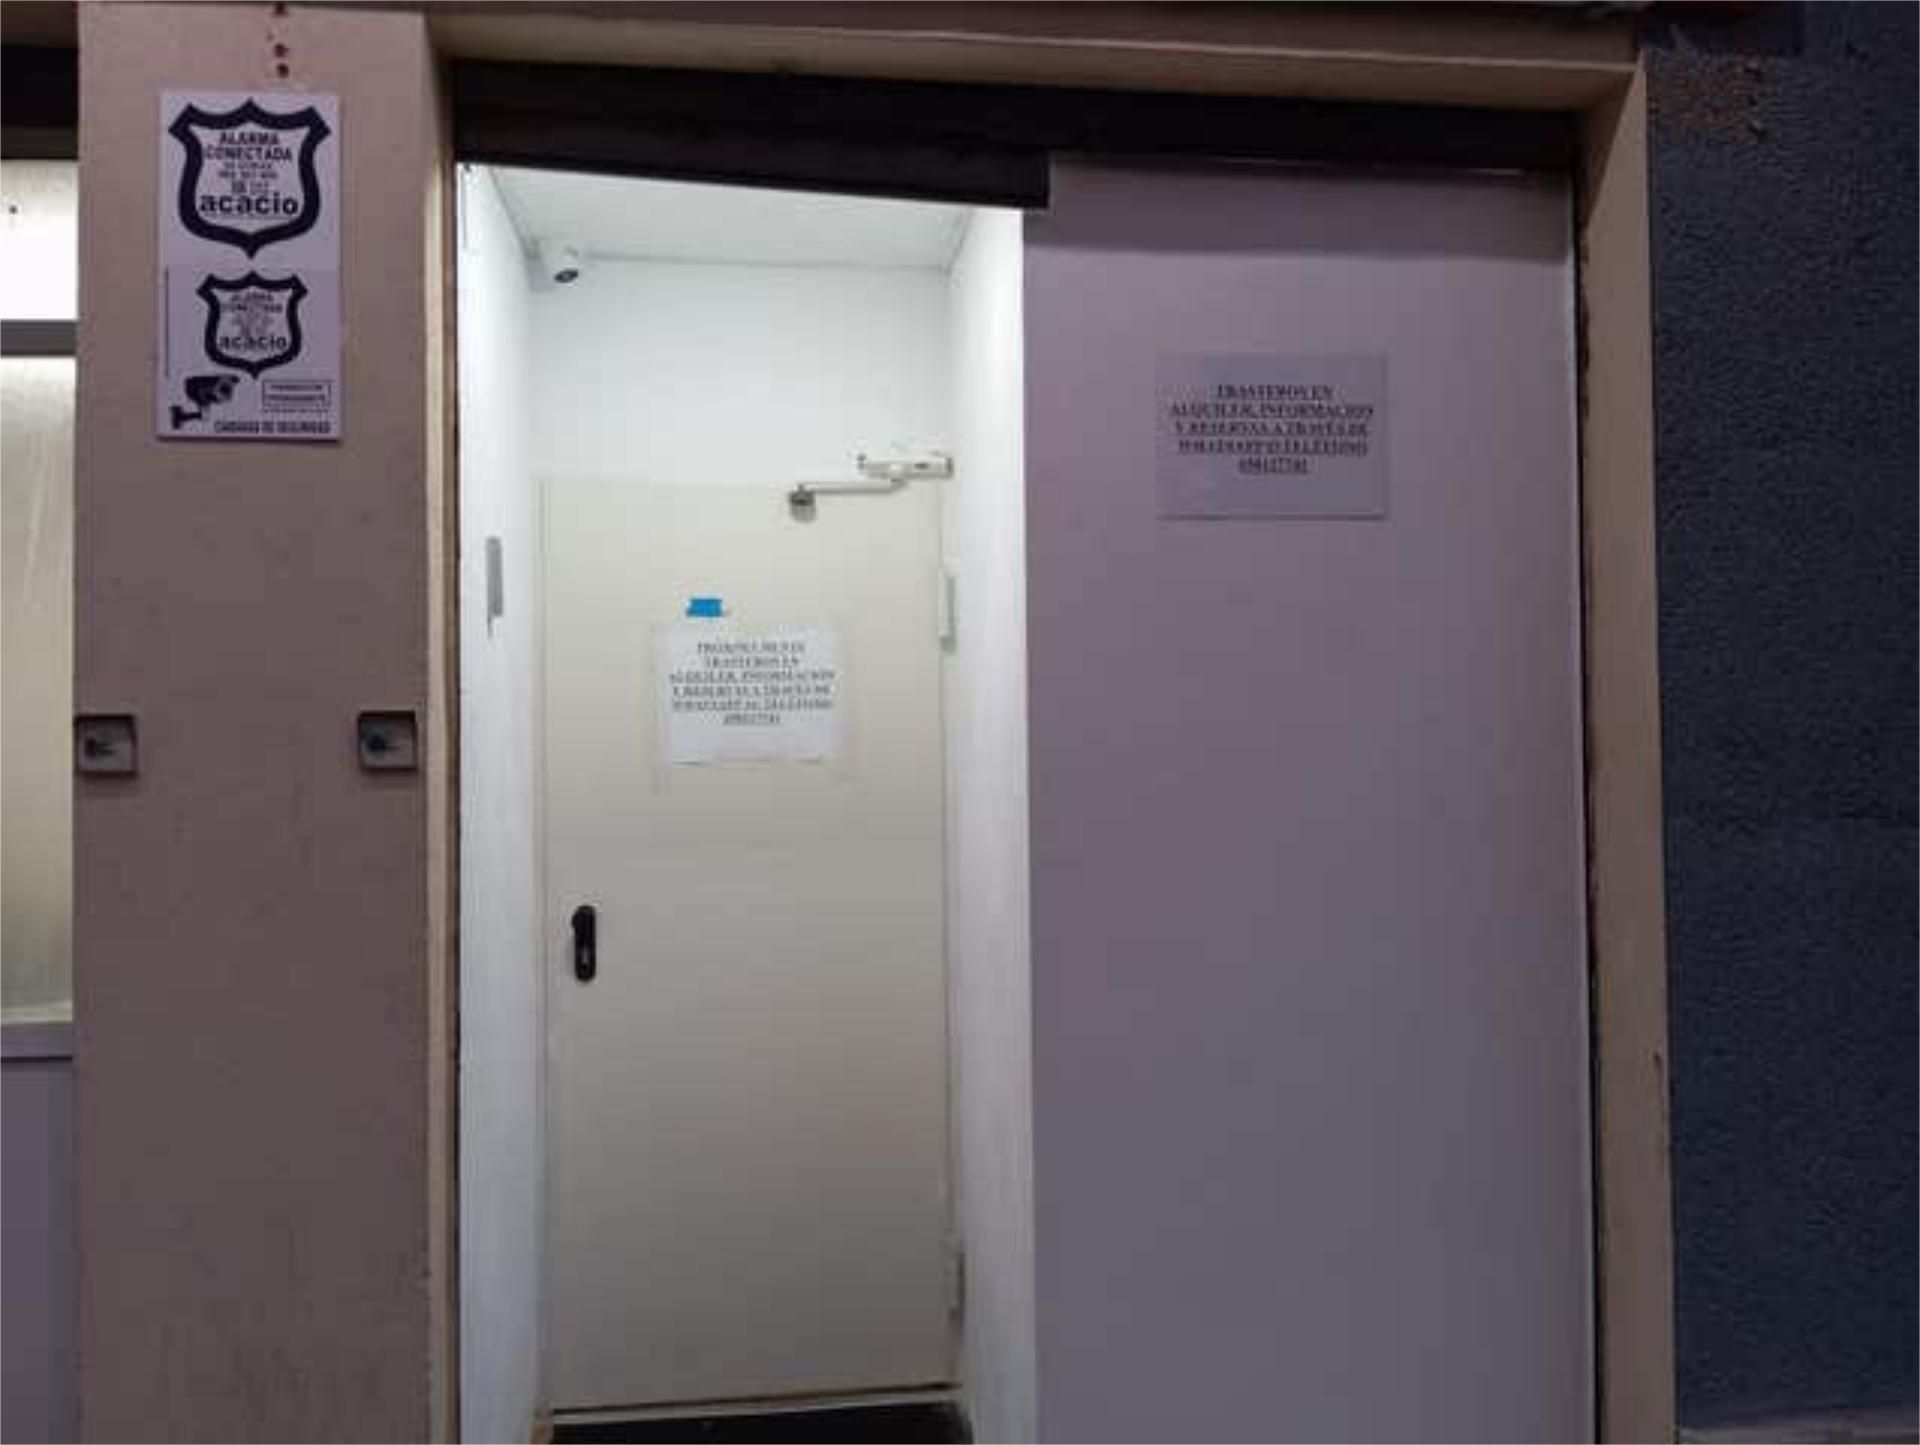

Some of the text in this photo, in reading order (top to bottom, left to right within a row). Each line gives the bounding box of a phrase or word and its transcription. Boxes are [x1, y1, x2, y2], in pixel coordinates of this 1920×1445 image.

[219, 132, 280, 145] ALARMA
[204, 146, 292, 160] CONECTADA
[200, 192, 298, 214] acacio
[219, 335, 287, 350] acacio
